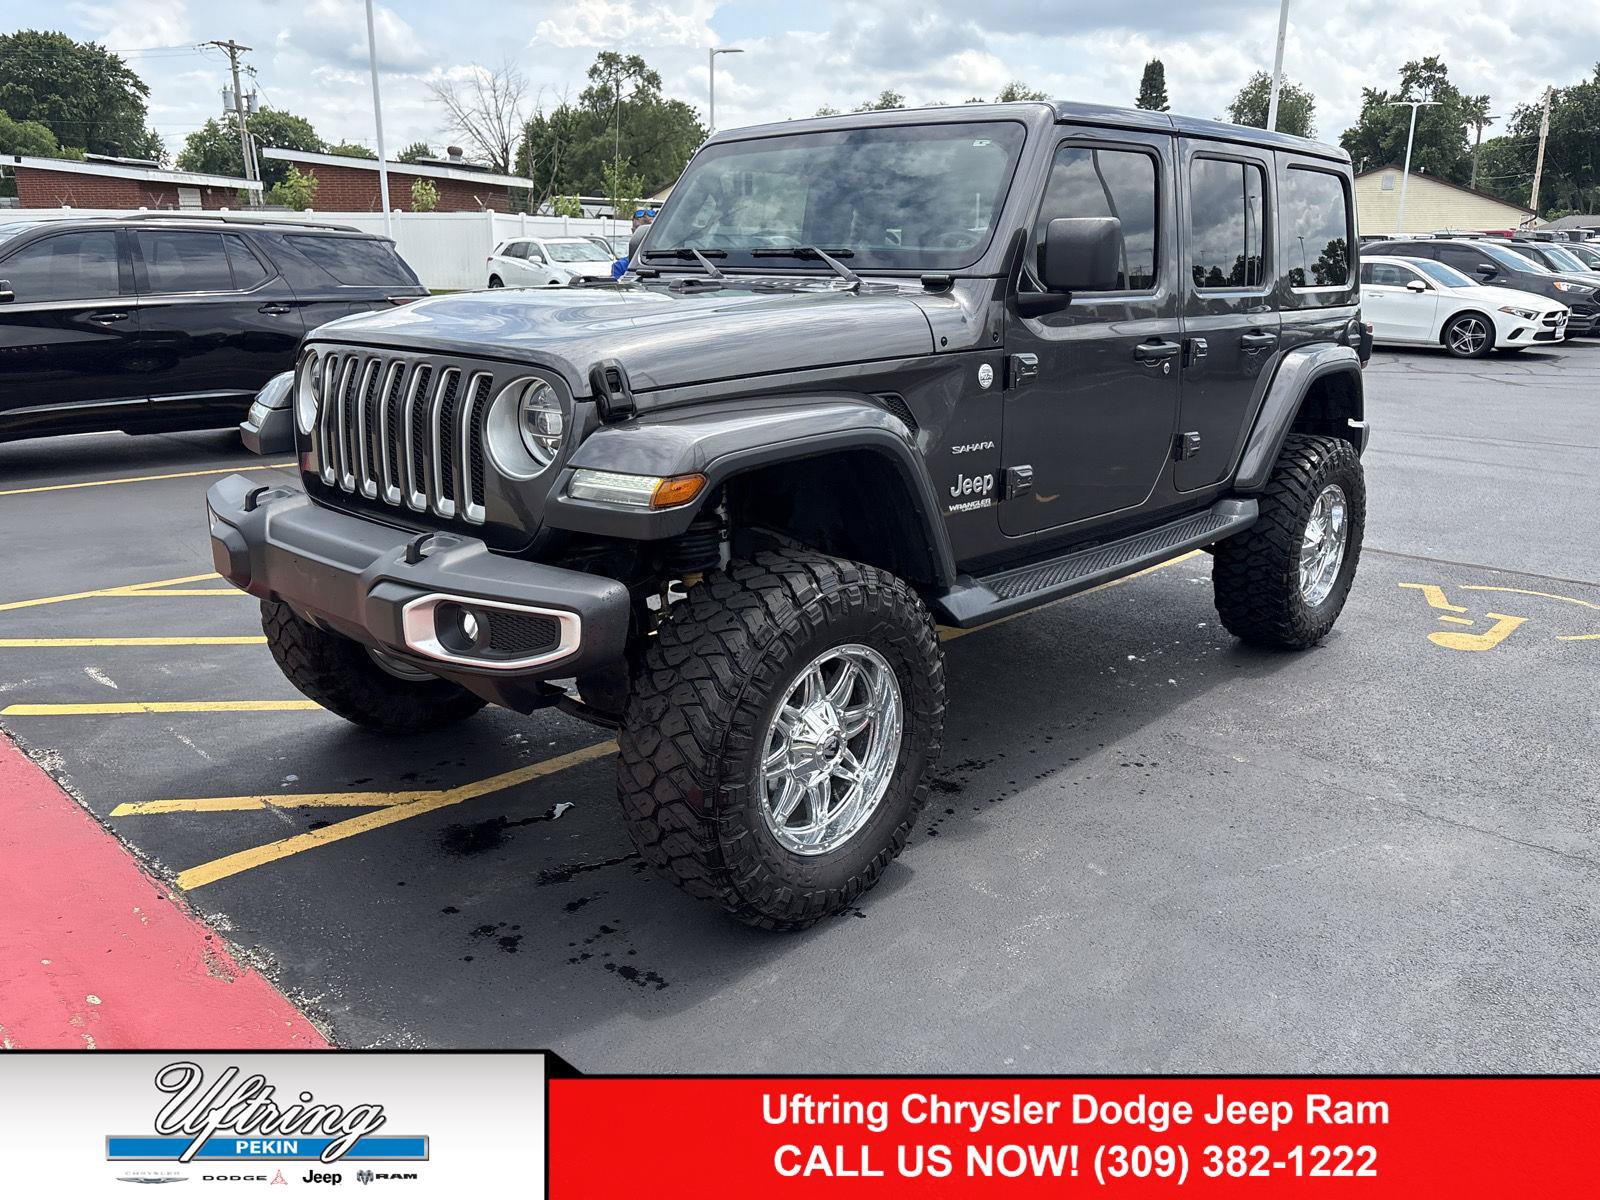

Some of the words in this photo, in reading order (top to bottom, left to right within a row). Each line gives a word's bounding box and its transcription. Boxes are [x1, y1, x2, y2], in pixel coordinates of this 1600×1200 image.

[951, 441, 995, 454] SAHARA
[950, 473, 994, 497] Jeep
[949, 498, 991, 511] WRANGLER
